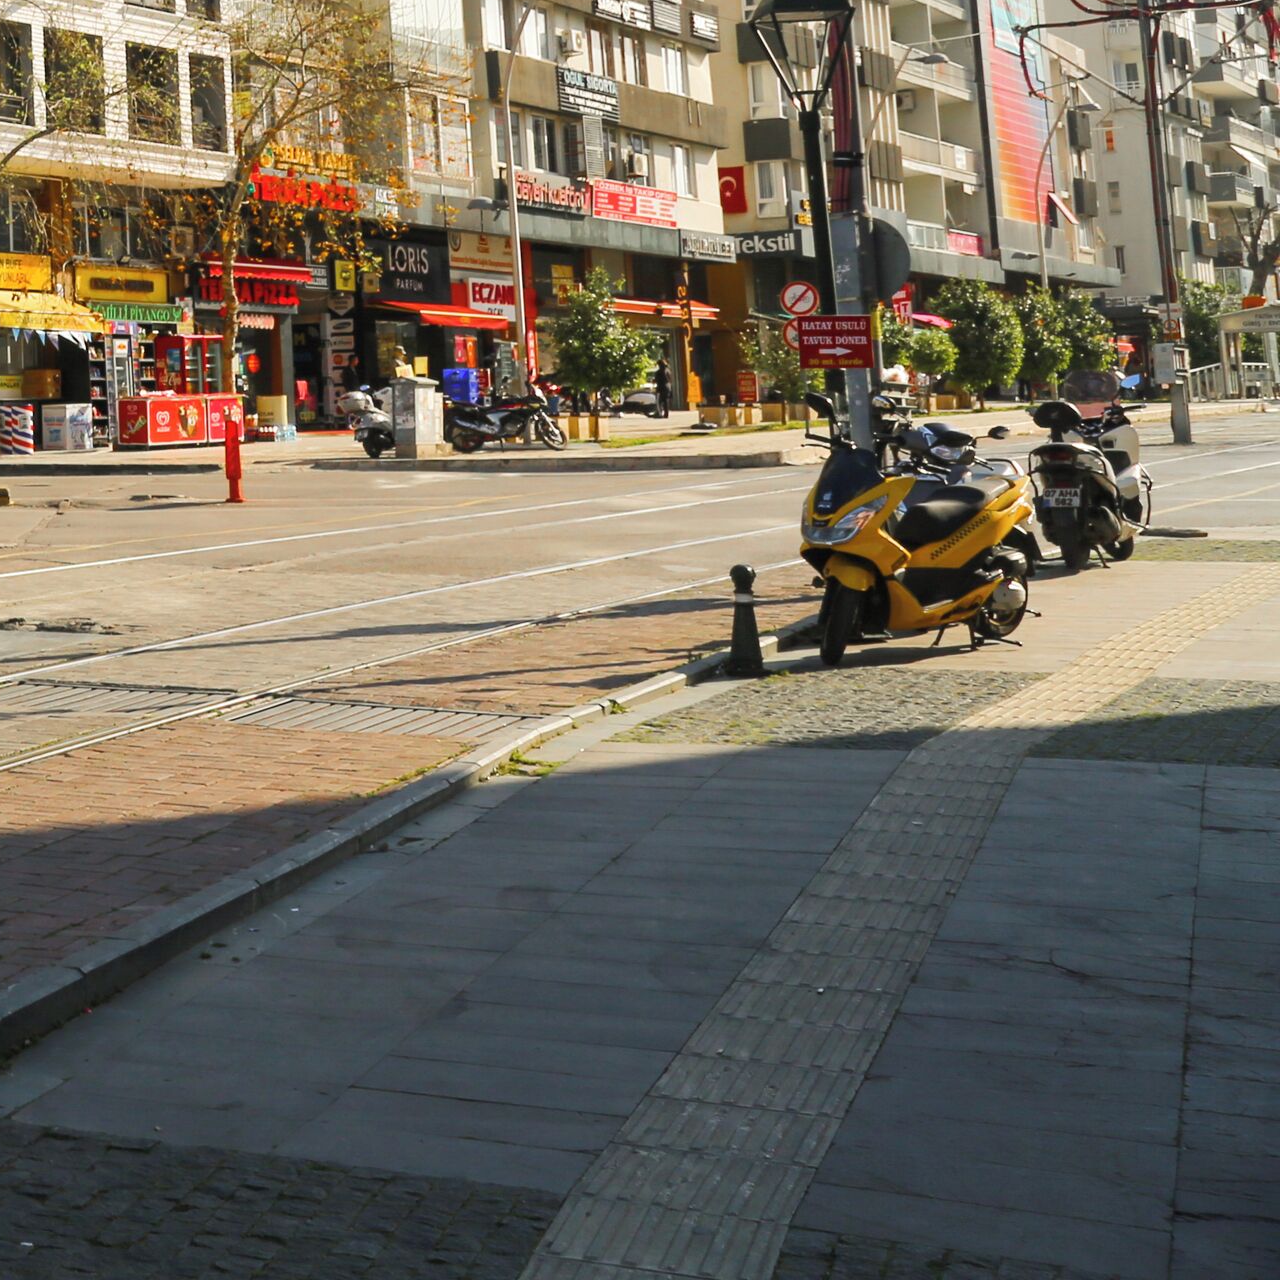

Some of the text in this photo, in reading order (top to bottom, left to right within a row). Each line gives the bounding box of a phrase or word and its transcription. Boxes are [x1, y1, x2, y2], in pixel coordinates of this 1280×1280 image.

[734, 232, 795, 254] Tekstil
[388, 245, 429, 274] LORIS
[472, 282, 515, 305] ECZAN
[802, 321, 832, 331] HATAY
[802, 335, 833, 345] TAVUK
[1044, 489, 1057, 497] 07
